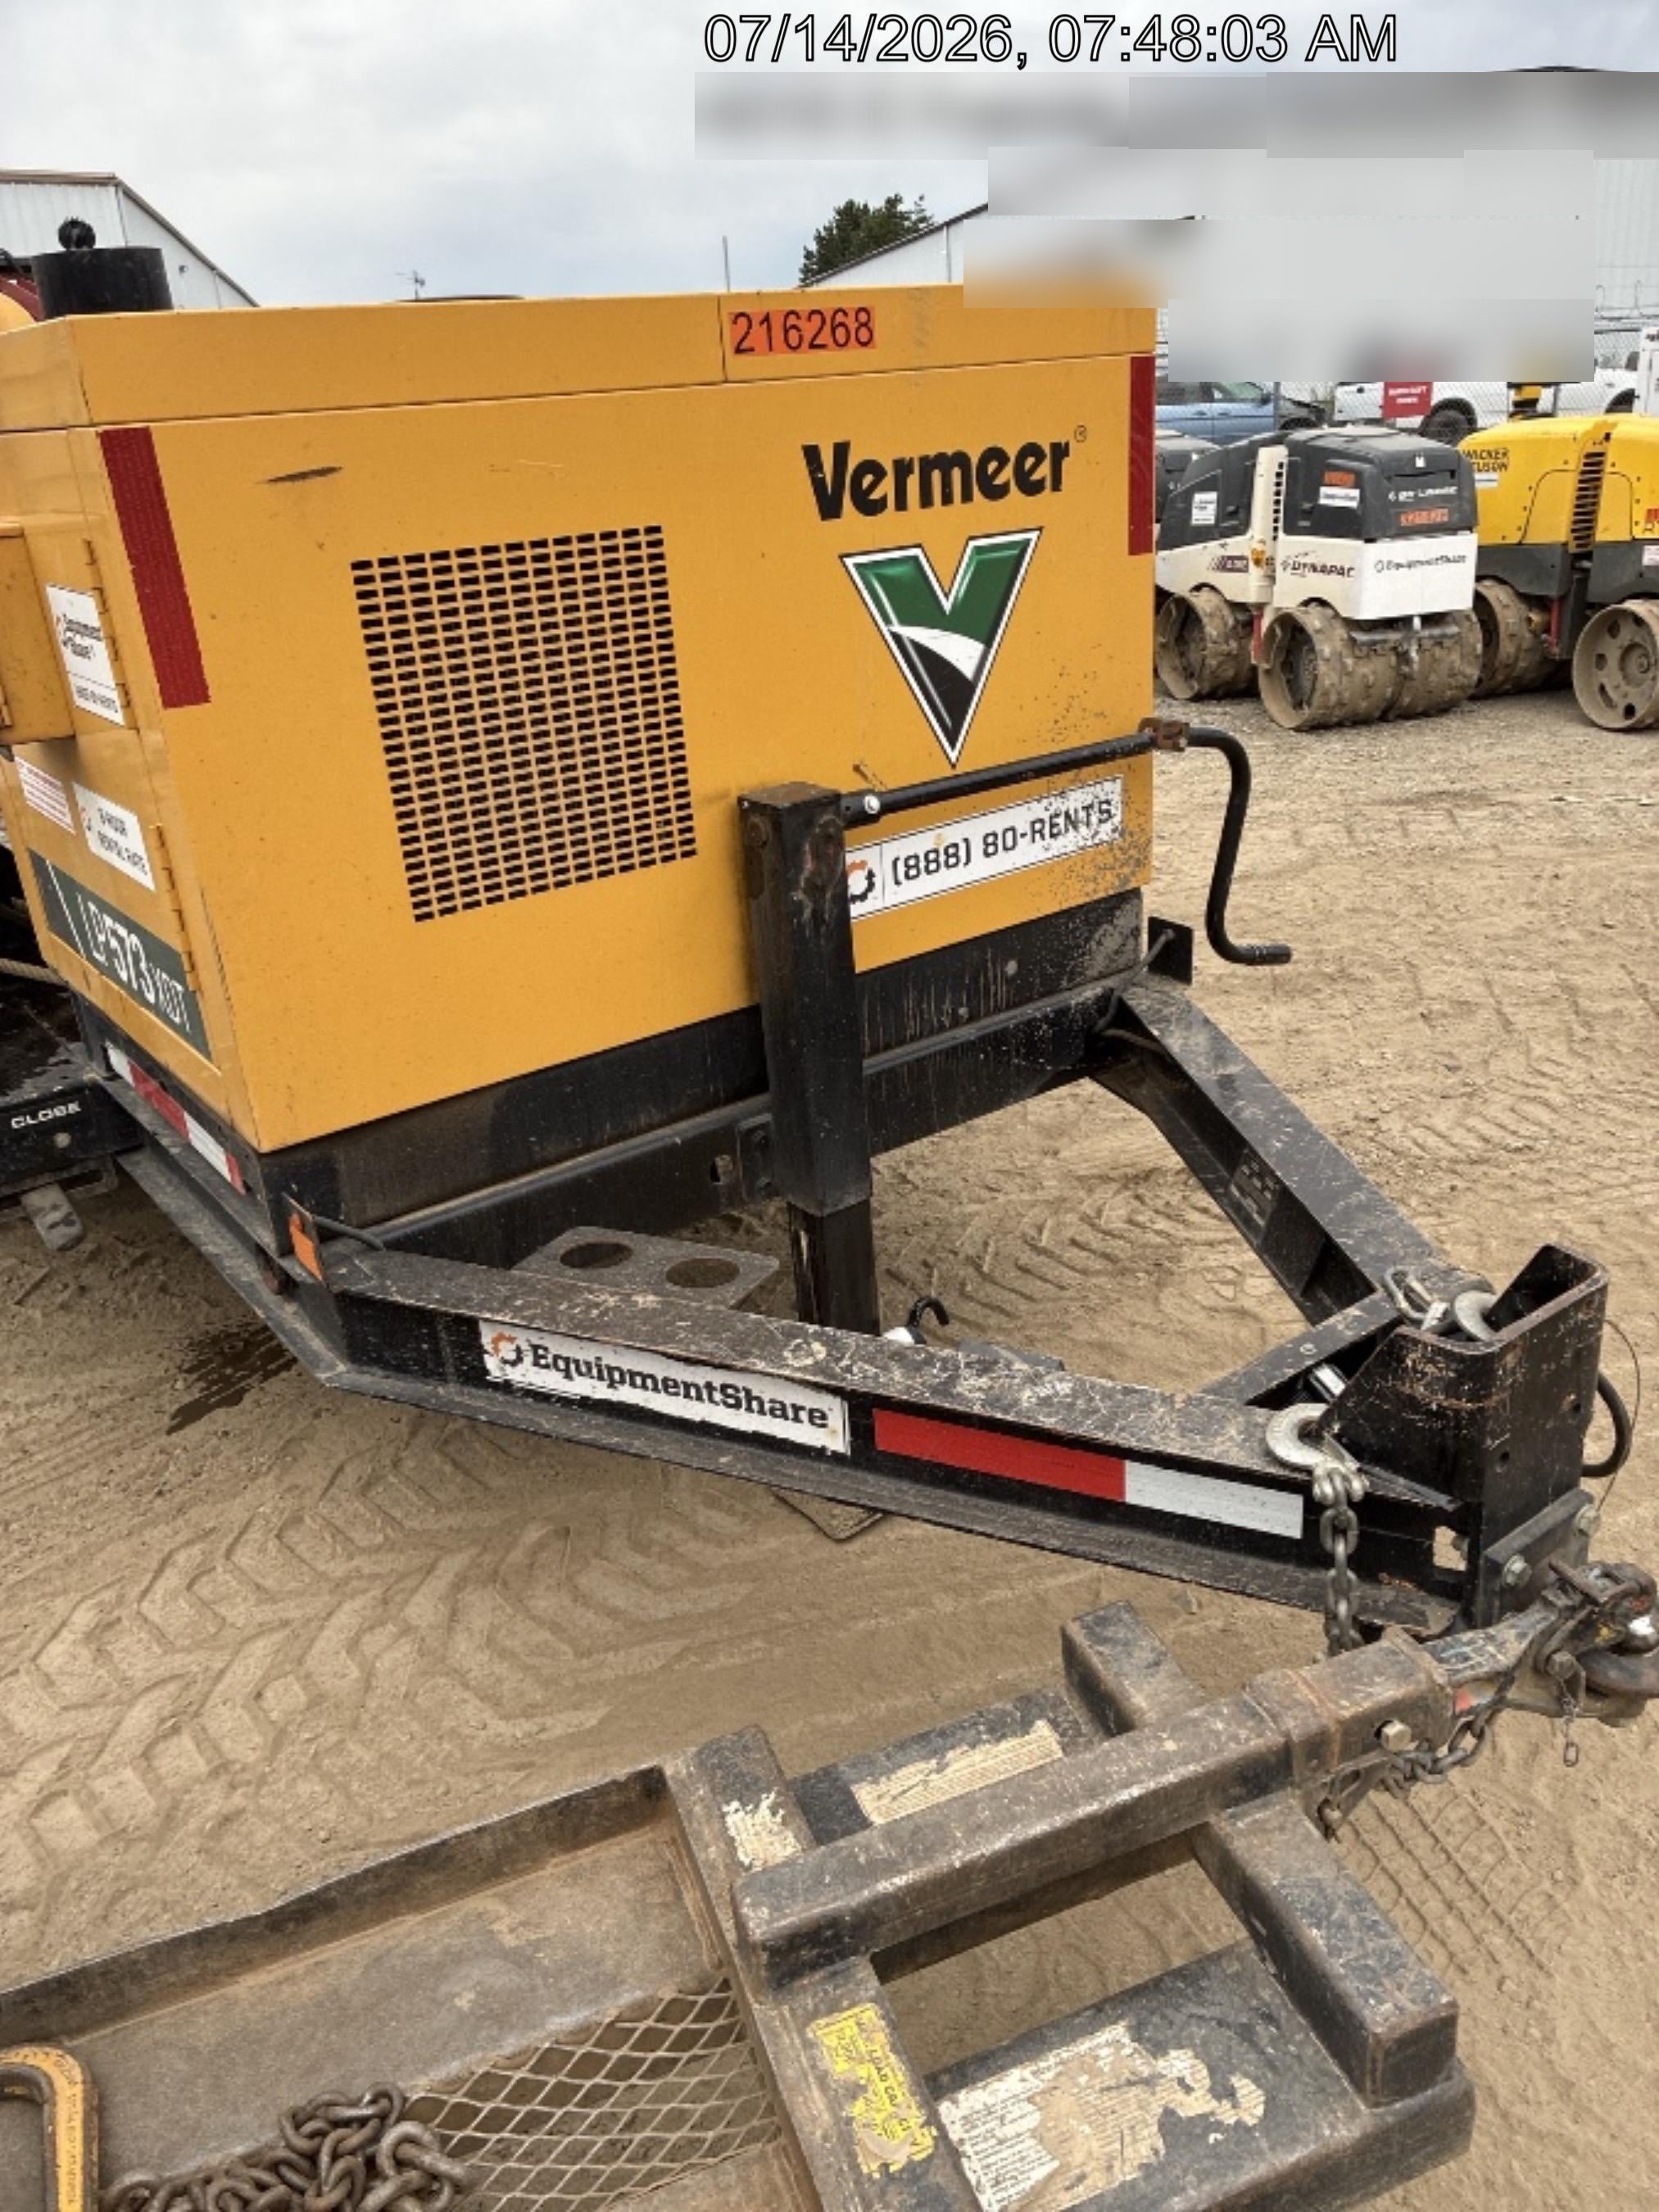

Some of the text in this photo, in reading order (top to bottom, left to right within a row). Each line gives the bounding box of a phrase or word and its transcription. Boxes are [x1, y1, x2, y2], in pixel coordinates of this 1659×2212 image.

[732, 306, 874, 355] 216268
[801, 438, 1071, 521] Vermeer
[891, 800, 1114, 886] (888) 80-RENTS
[528, 1342, 829, 1429] EquipmentShare
